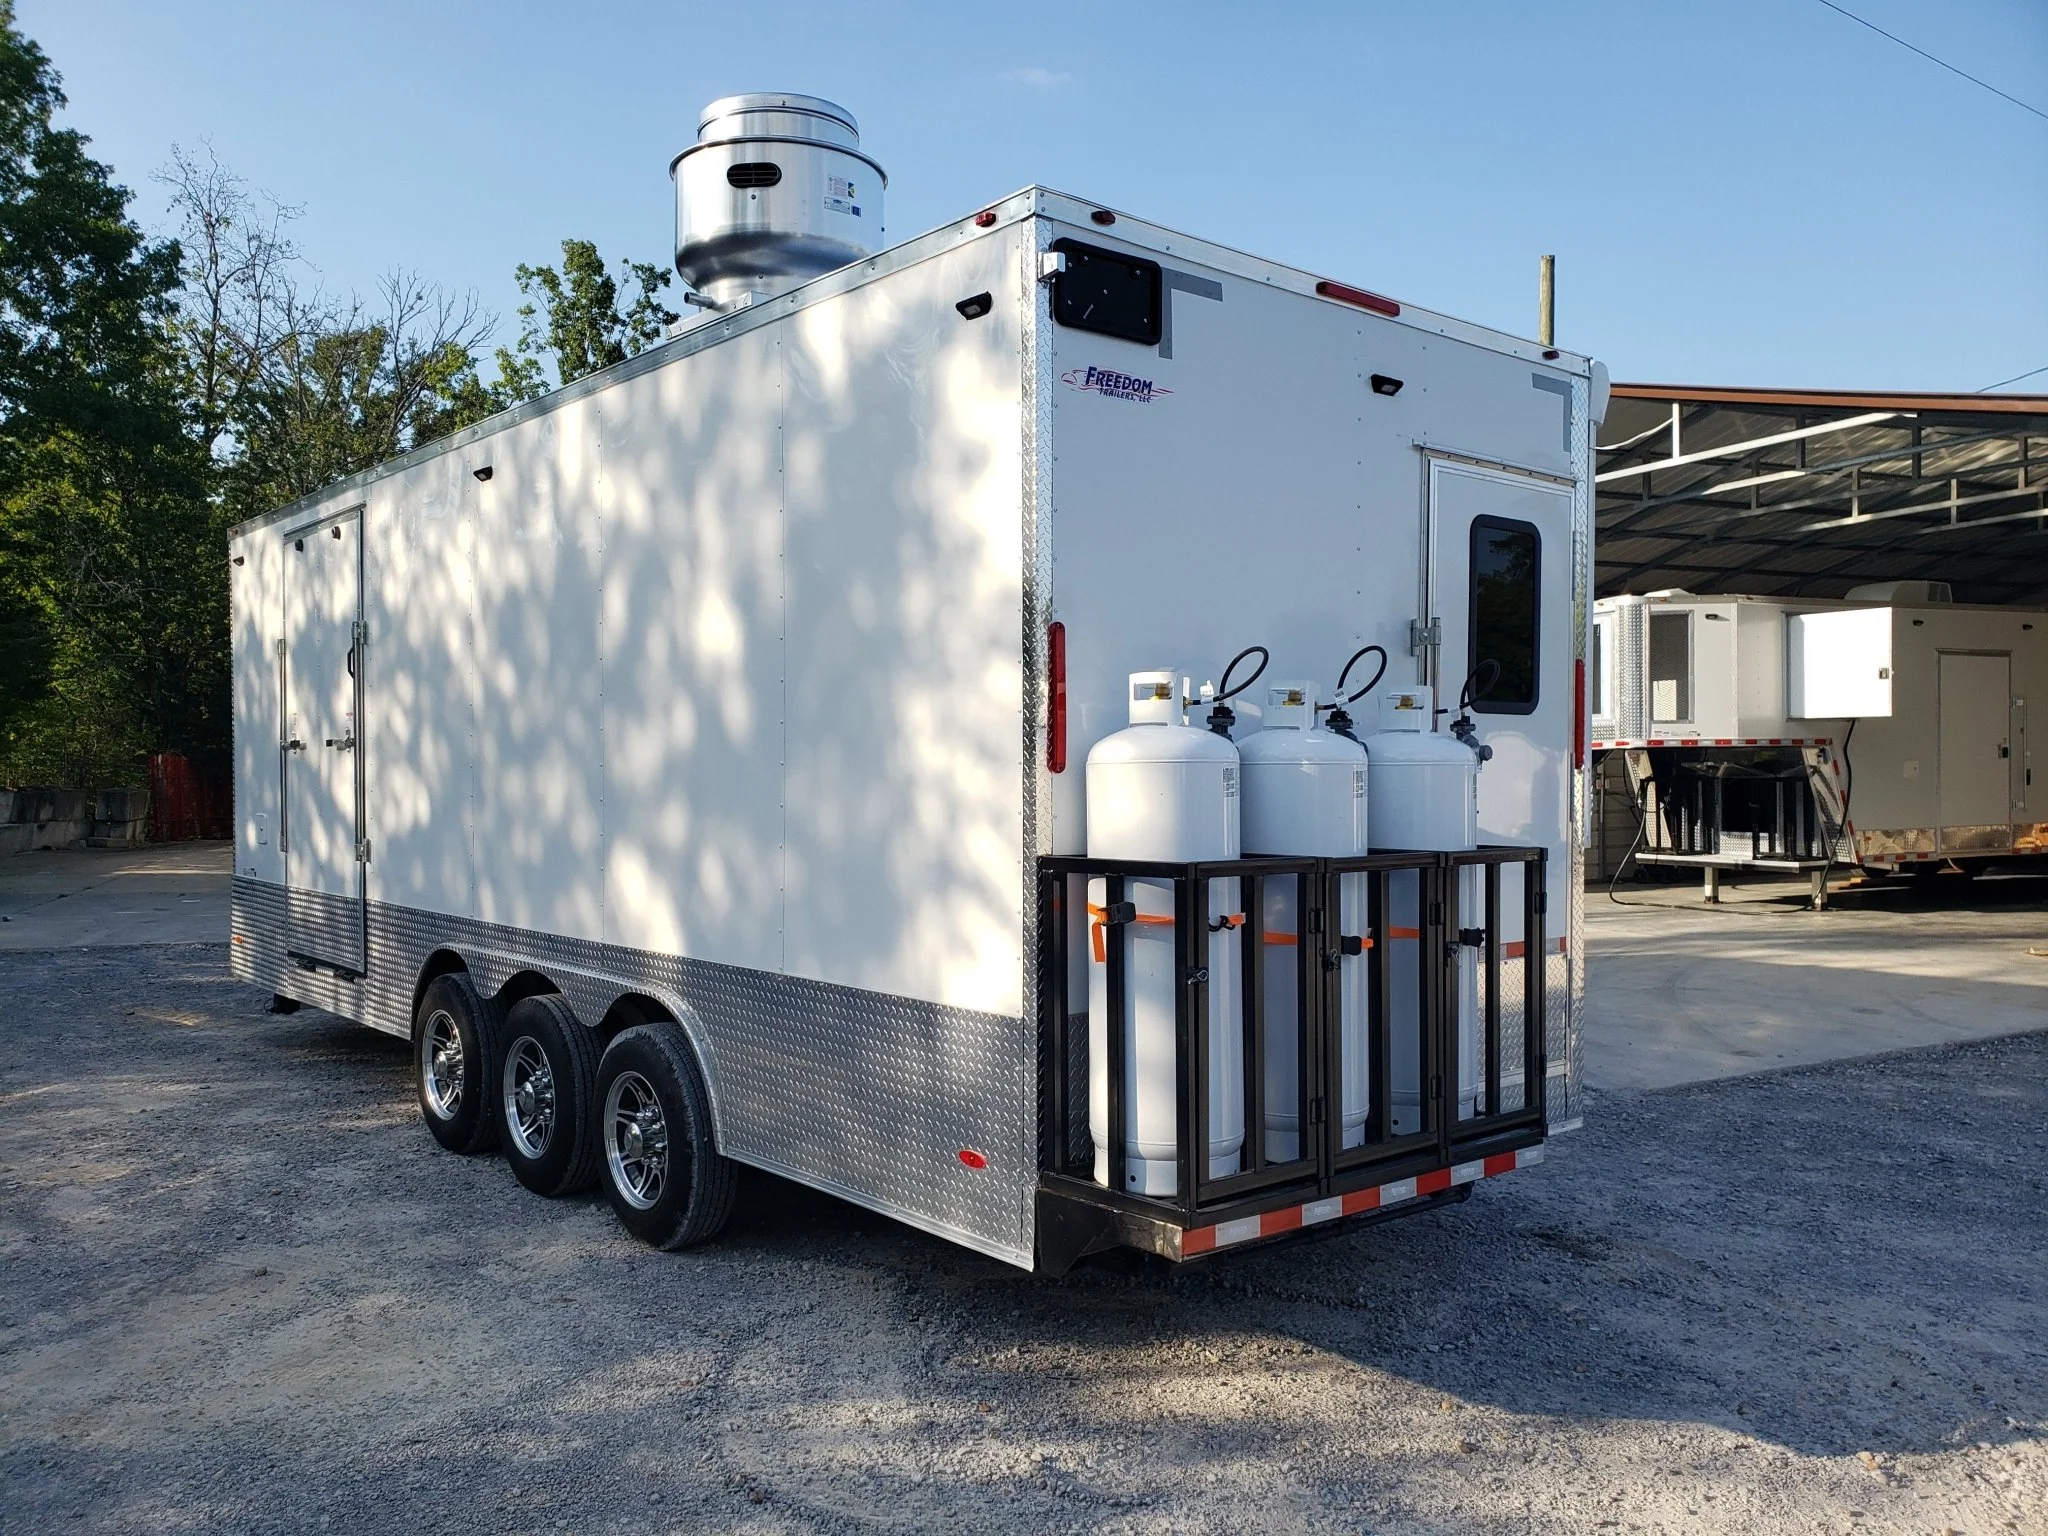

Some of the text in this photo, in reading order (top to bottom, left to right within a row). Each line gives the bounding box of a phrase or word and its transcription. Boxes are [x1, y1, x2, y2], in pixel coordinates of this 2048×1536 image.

[1085, 366, 1153, 394] FREEDOM
[1099, 388, 1152, 404] TRAILERS, LLC
